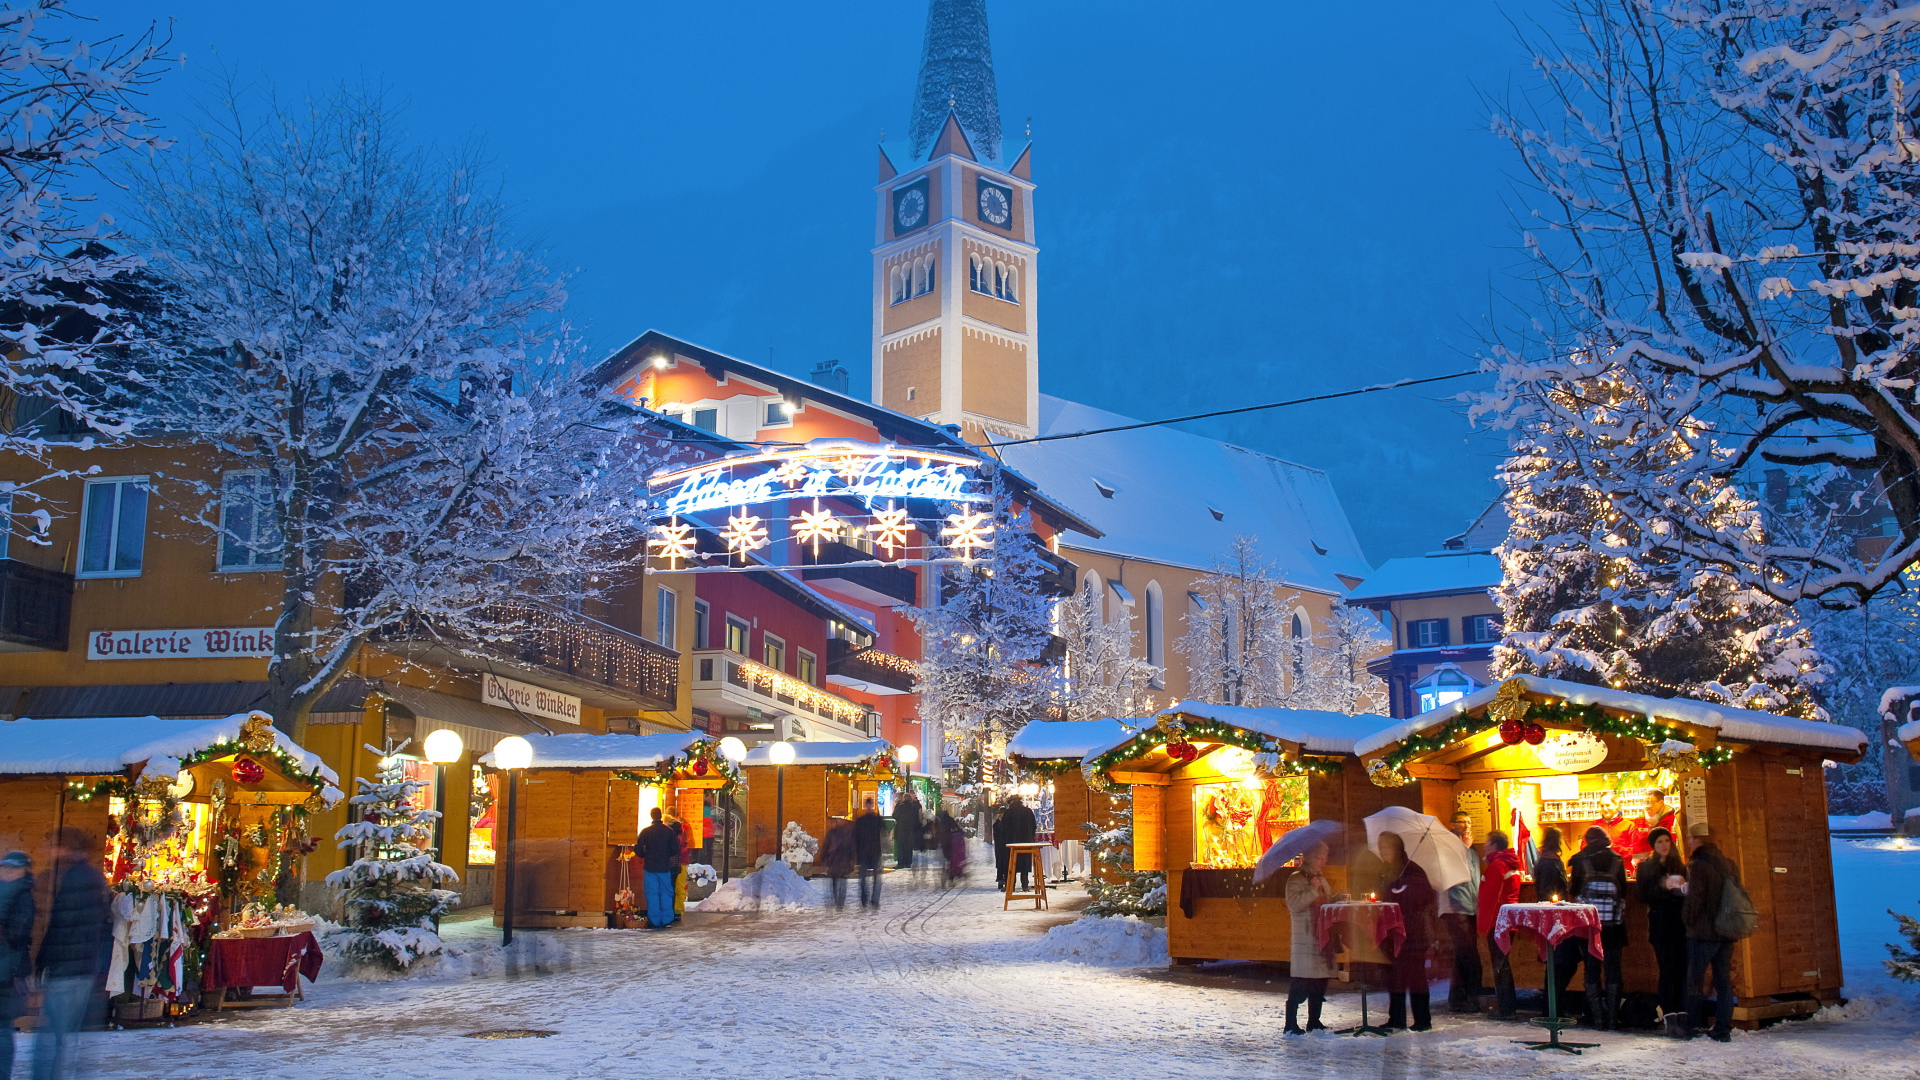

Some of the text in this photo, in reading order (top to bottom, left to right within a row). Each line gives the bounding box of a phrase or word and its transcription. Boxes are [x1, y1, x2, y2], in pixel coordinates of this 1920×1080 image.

[95, 629, 275, 656] Galerie Wink
[487, 676, 577, 718] Galerie Winkler
